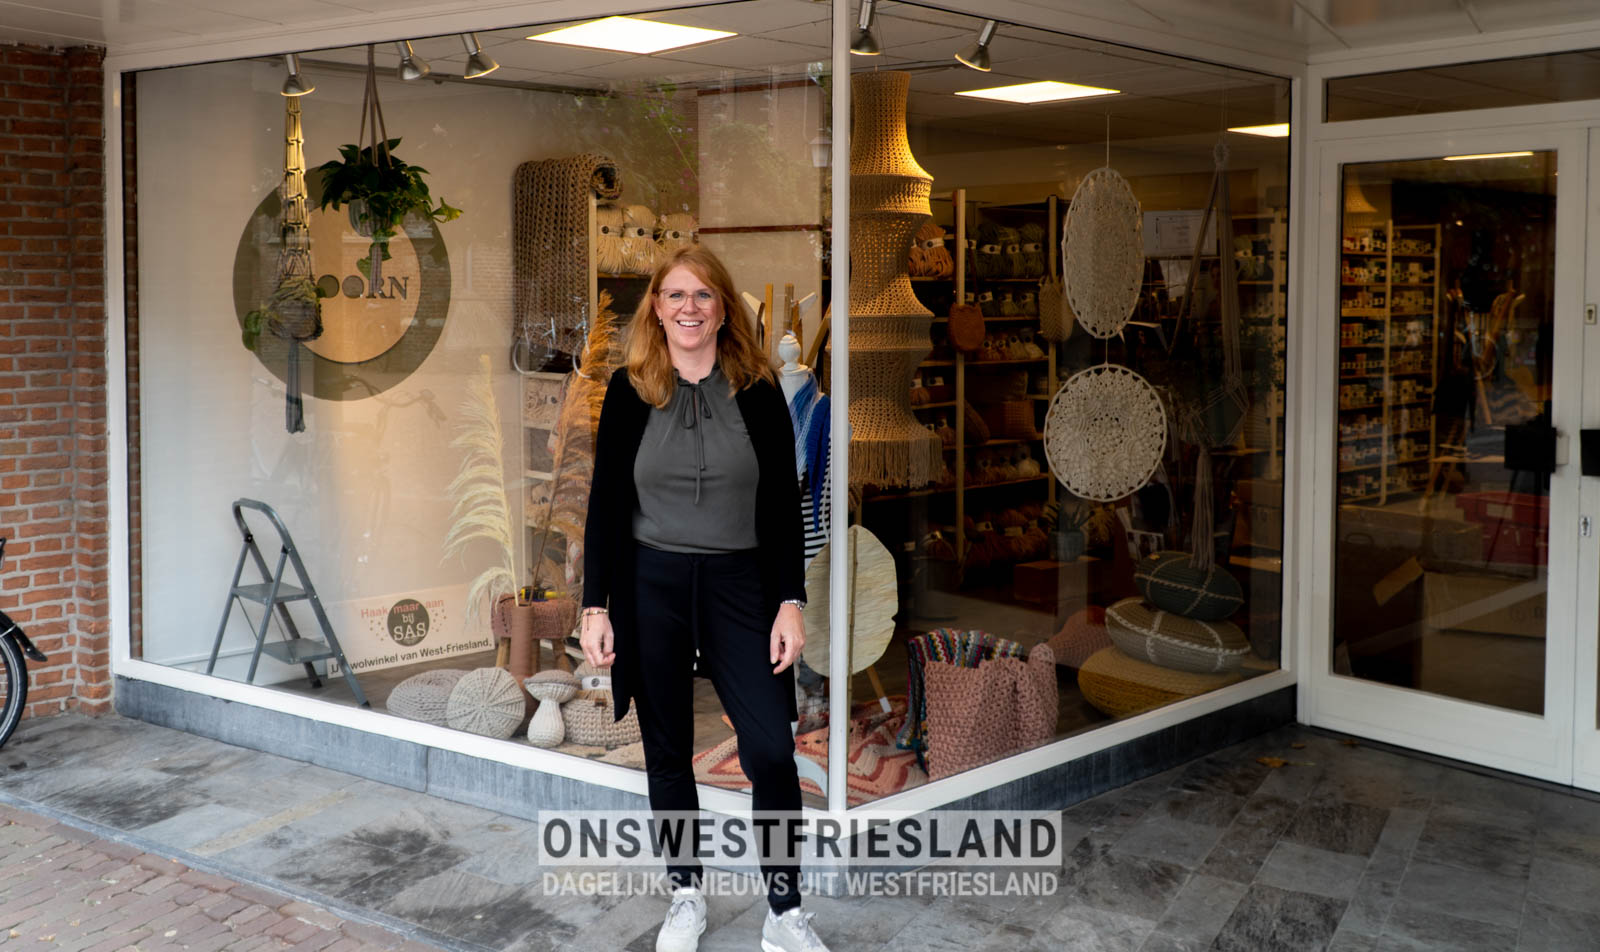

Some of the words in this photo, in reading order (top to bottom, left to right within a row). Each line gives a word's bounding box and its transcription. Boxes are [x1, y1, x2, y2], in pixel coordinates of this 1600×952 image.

[317, 274, 409, 300] OORN
[361, 606, 388, 619] Haak
[393, 602, 420, 614] maar
[425, 599, 444, 609] aan
[393, 622, 426, 641] SAS
[350, 653, 398, 671] wolwinkel
[401, 651, 418, 661] van
[420, 638, 492, 658] West-Friesland.
